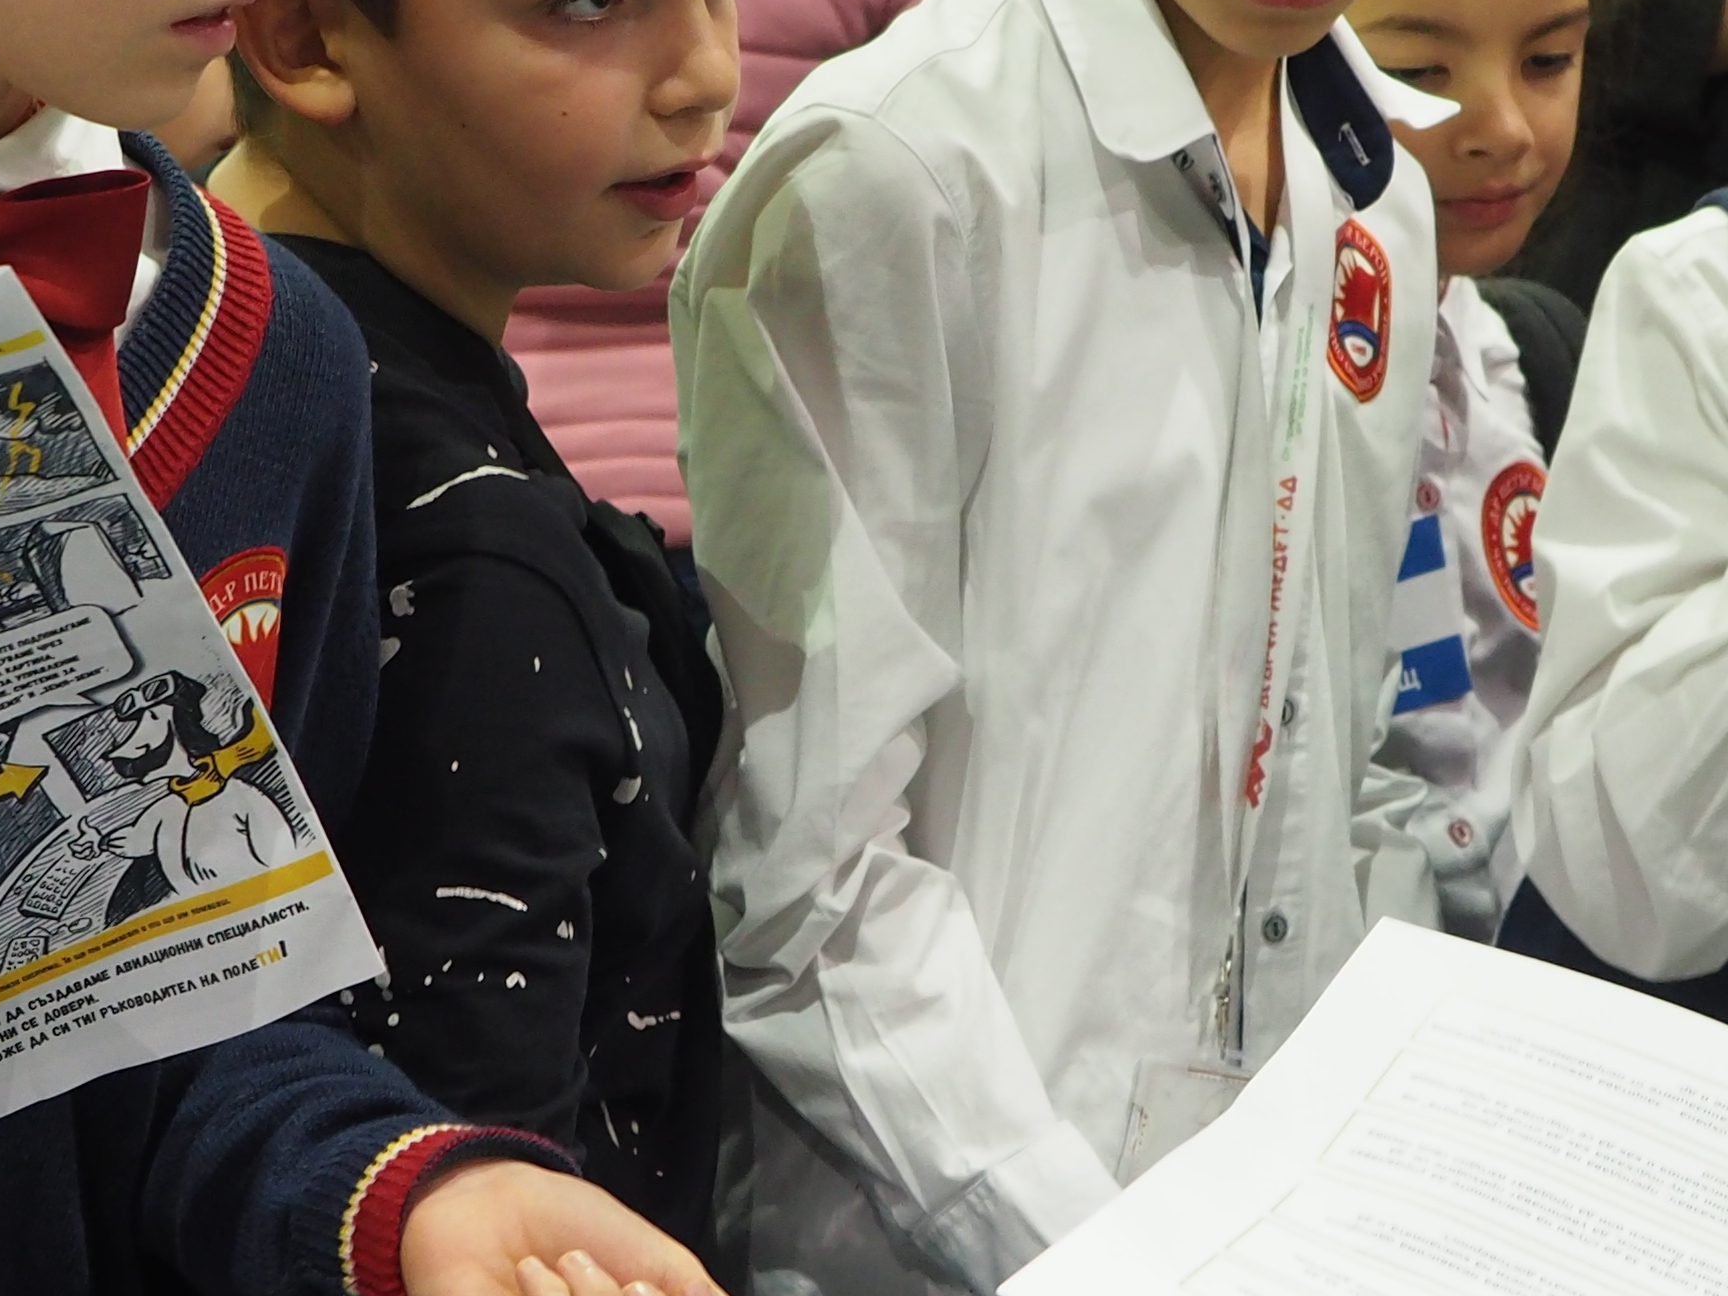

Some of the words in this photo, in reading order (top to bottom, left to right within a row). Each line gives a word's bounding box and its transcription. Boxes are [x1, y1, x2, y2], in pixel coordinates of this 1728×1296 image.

[36, 637, 64, 653] ЧРЕЗ
[14, 653, 80, 682] УПРАВЛЕНИЕ
[2, 1004, 27, 1023] ДА
[26, 968, 112, 1012] СЪЗДАВАМЕ
[113, 936, 204, 976] АВИАЦИОННИ
[205, 898, 310, 947] СПЕЦИАЛИСТИ.
[19, 1016, 40, 1033] СЕ
[41, 992, 100, 1025] ДОВЕРИ.
[26, 1030, 51, 1049] ДА
[50, 1021, 72, 1038] СИ
[72, 1011, 98, 1030] ТИ!
[99, 977, 198, 1020] РЪКОВОДИТЕЛ
[198, 970, 220, 988] НА
[221, 938, 290, 981] ПОЛЕТИ!
